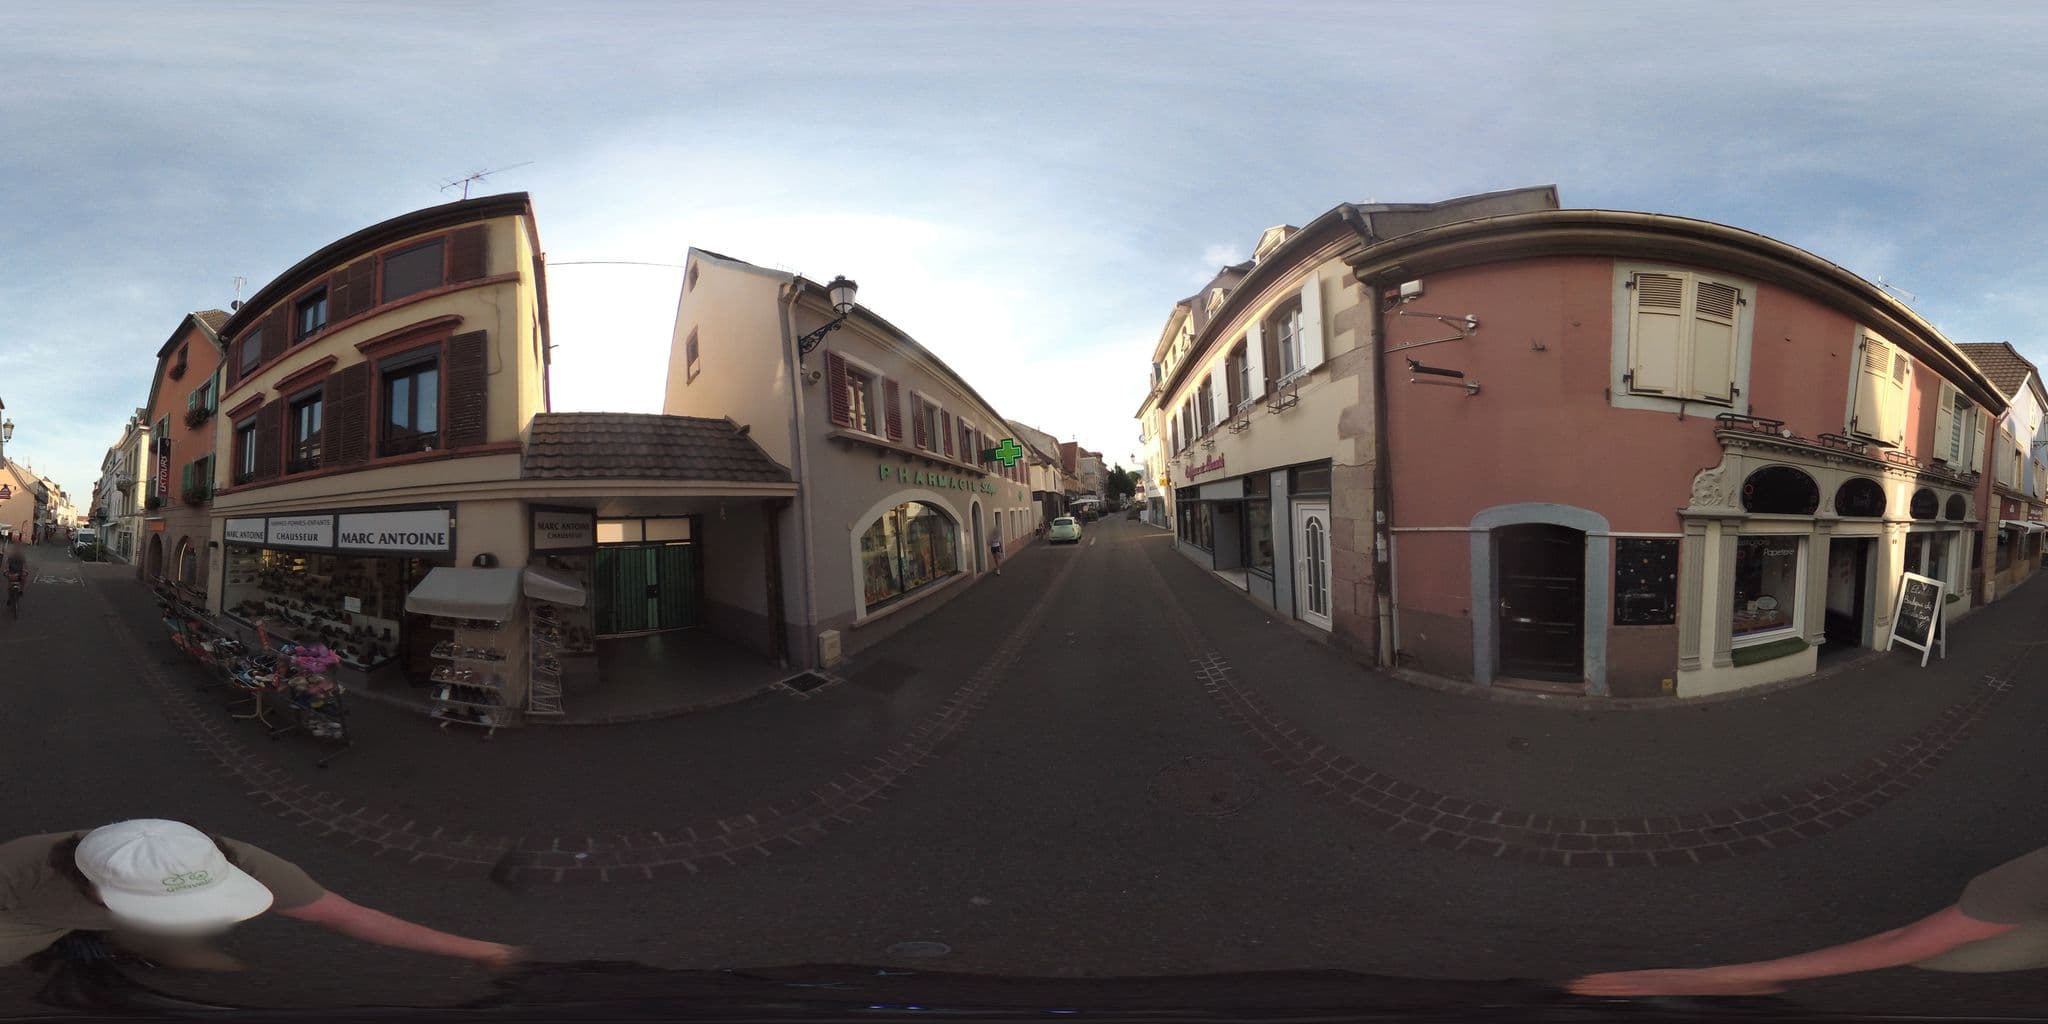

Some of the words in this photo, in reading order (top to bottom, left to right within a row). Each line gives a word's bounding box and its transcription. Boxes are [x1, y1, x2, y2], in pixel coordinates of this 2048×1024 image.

[276, 532, 319, 542] CHAUSSEUR
[340, 532, 375, 545] MARC
[378, 532, 446, 546] ANTOINE
